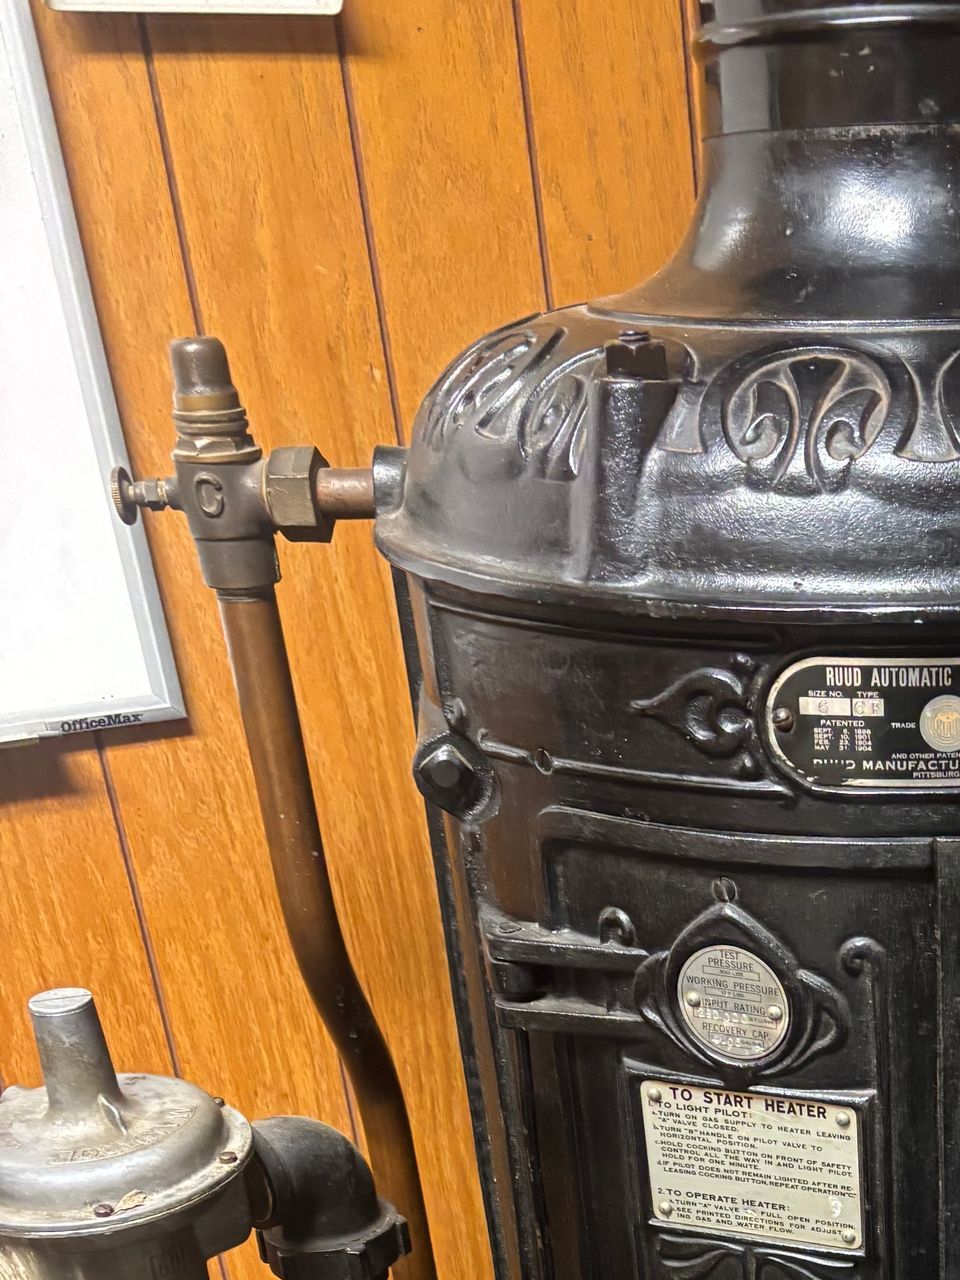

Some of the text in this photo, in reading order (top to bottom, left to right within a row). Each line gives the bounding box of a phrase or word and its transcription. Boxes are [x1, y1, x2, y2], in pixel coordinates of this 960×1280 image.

[826, 666, 861, 686] RUUD
[871, 666, 952, 686] AUTOMATIC
[60, 714, 142, 732] OfficeMax
[708, 958, 754, 971] PRESSURE
[720, 952, 738, 960] TEST
[686, 976, 728, 989] WORKING
[734, 982, 779, 996] PRESSURE
[700, 998, 766, 1015] INPUT RATING
[702, 1022, 747, 1036] RECOVERY
[657, 1101, 752, 1119] TO LIGHT PILOT:
[669, 1088, 827, 1119] TO START HEATER
[702, 1123, 739, 1132] CLOSED.
[724, 1119, 757, 1128] SUPPLY
[778, 1126, 811, 1135] HEATER
[817, 1131, 851, 1140] LEAVING
[660, 1132, 758, 1149] HORIZONTAL POSITION.
[699, 1130, 733, 1139] HANDLE
[782, 1141, 806, 1149] VALVE
[661, 1146, 700, 1156] CONTROL
[798, 1165, 823, 1173] LIGHT
[686, 1143, 721, 1153] COCKING
[725, 1149, 758, 1157] BUTTON
[776, 1155, 804, 1164] FRONT
[821, 1162, 852, 1170] SAFETY
[729, 1162, 761, 1170] MINUTE.
[742, 1172, 771, 1180] REMAIN
[774, 1176, 809, 1185] LIGHTED
[812, 1181, 838, 1189] AFTER
[666, 1188, 682, 1196] TO
[686, 1191, 738, 1204] OPERATE
[742, 1199, 790, 1212] HEATER:
[737, 1222, 765, 1230] WATER
